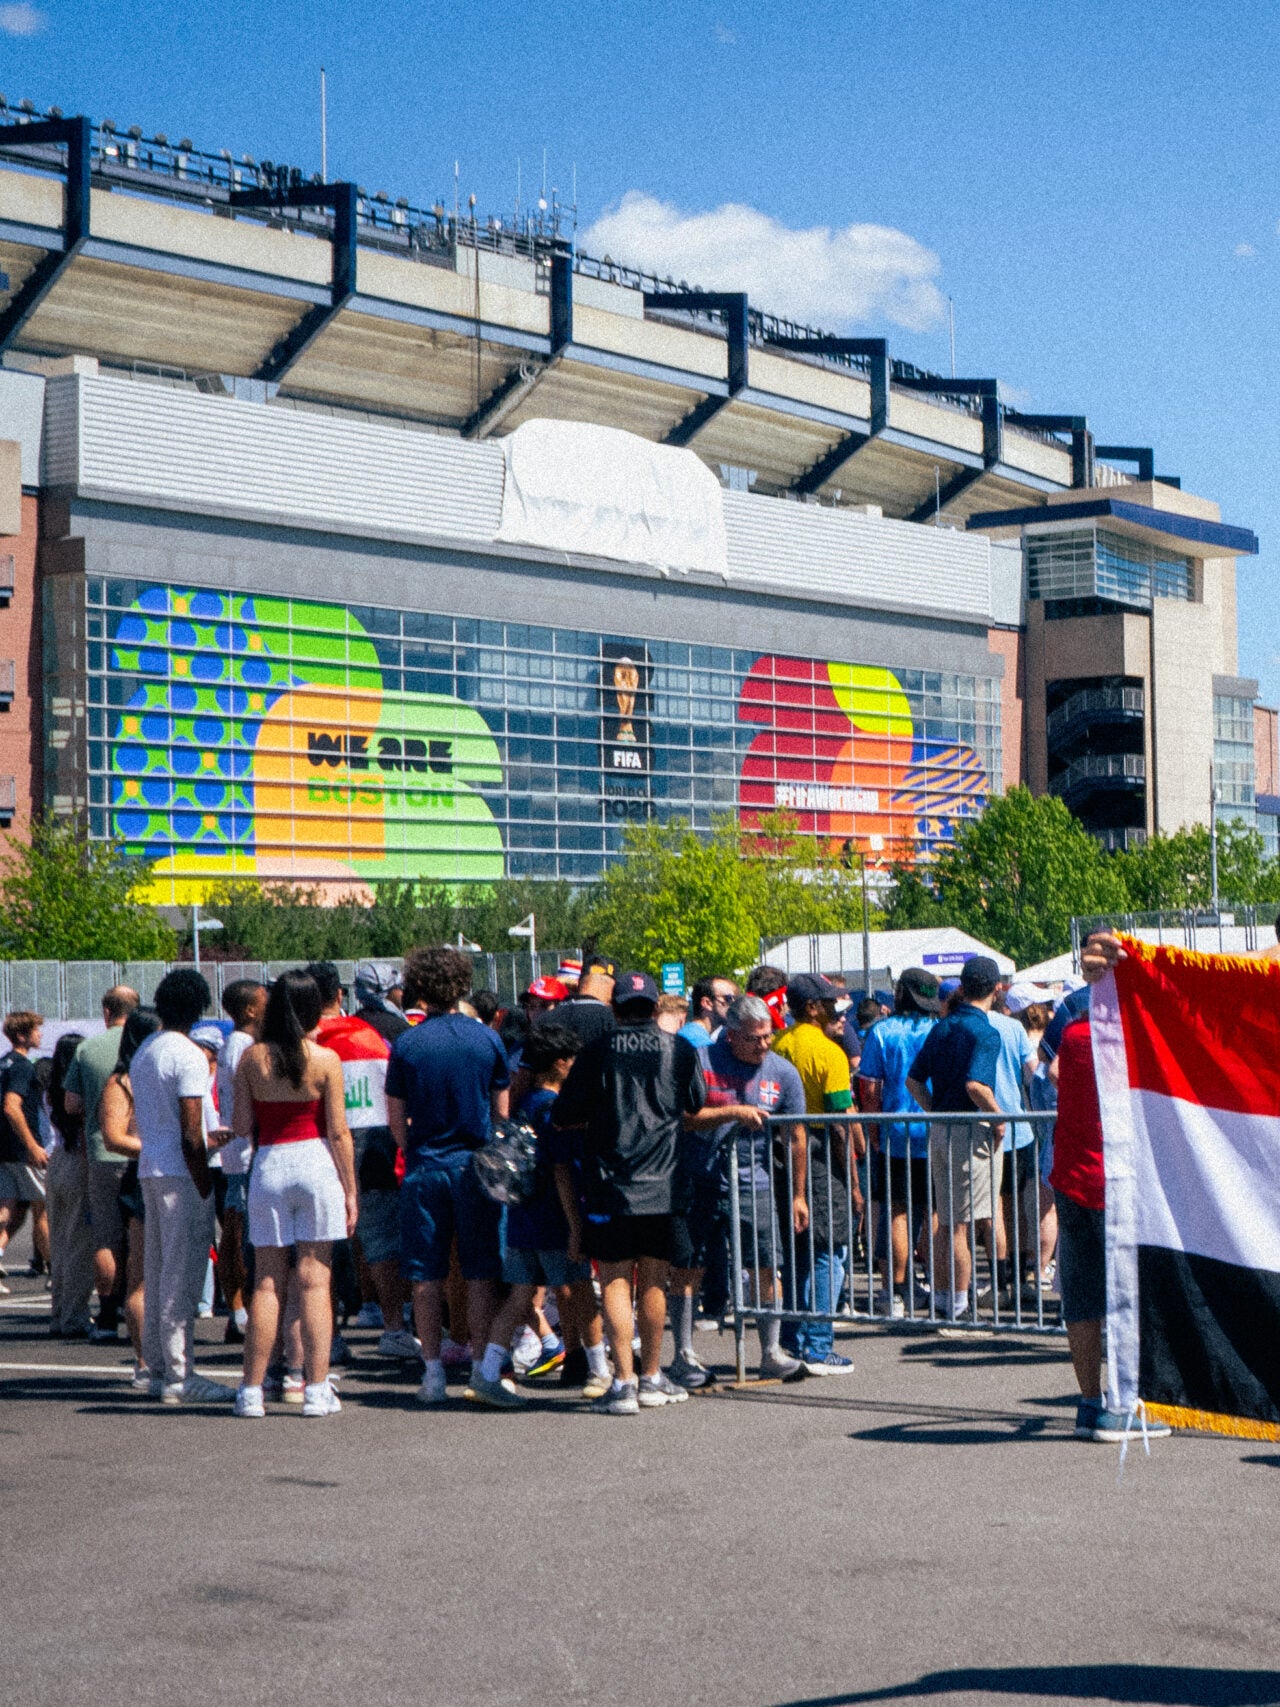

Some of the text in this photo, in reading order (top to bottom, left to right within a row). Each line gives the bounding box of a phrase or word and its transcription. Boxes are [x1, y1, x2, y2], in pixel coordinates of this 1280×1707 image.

[308, 732, 453, 774] WE ARE
[613, 750, 642, 768] FIFA
[308, 776, 454, 808] BOSTON
